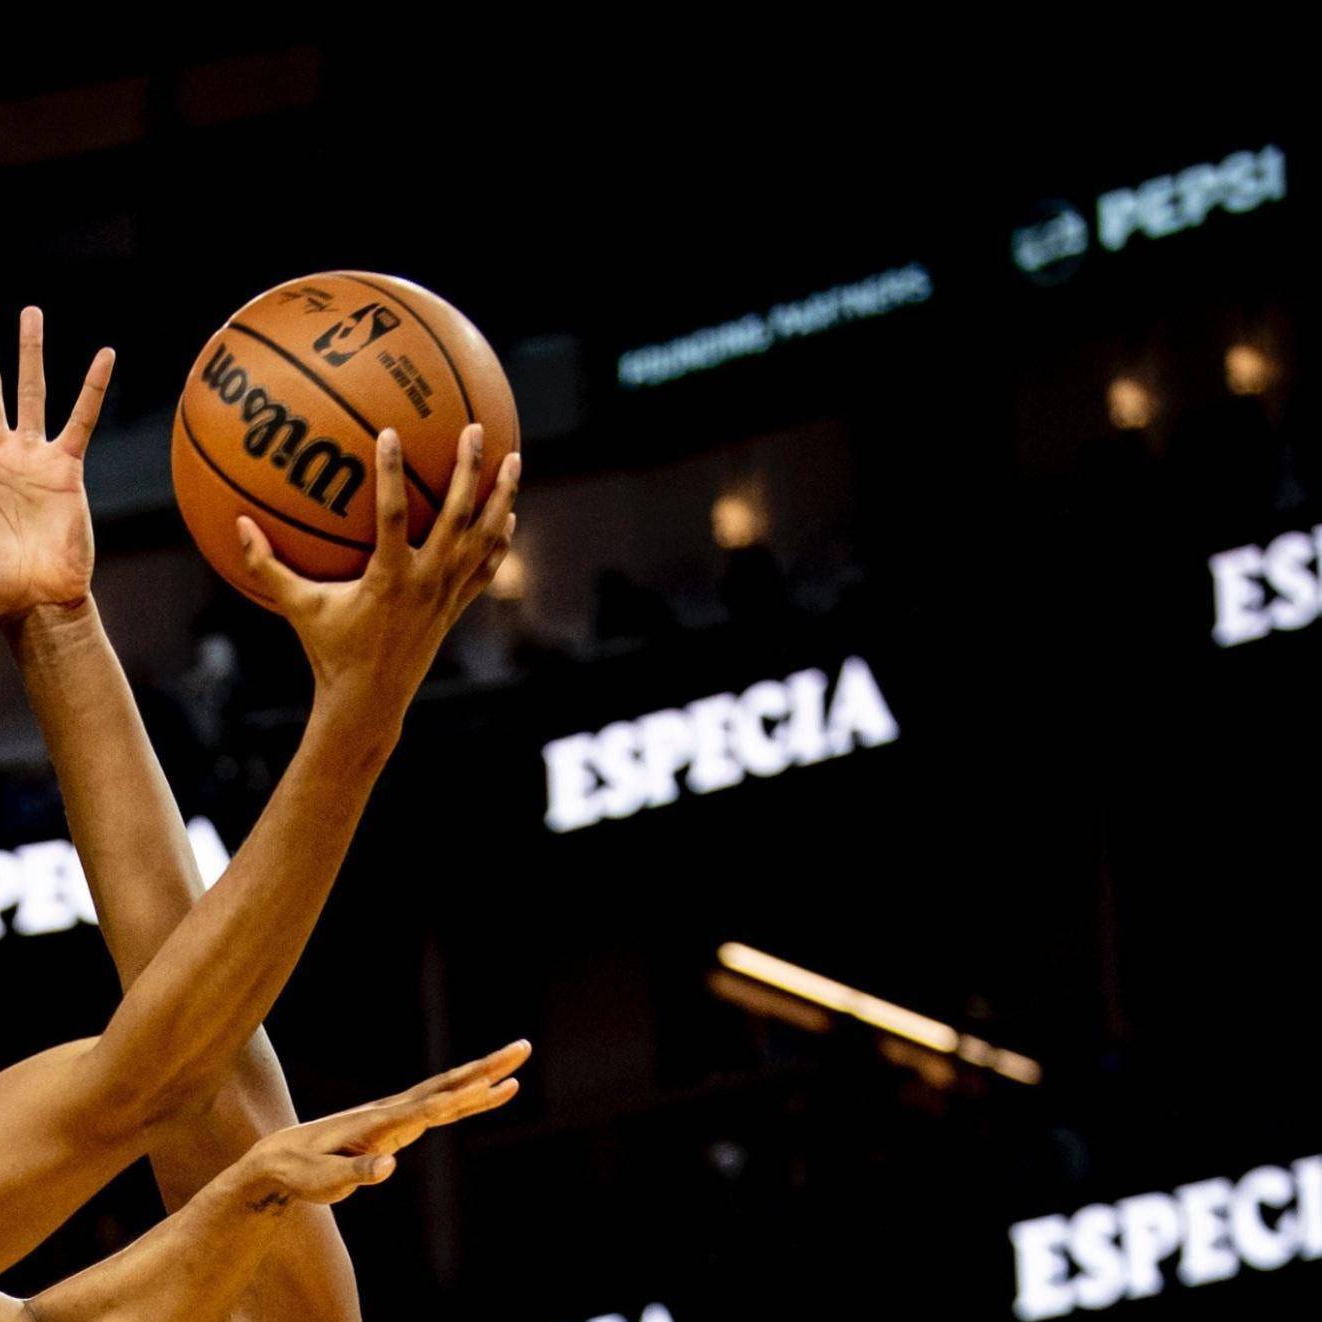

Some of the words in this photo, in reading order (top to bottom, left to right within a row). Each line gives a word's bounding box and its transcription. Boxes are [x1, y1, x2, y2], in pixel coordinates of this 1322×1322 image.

[1095, 143, 1286, 252] PEPSI
[201, 342, 367, 519] Wilson
[1208, 523, 1322, 647] ES
